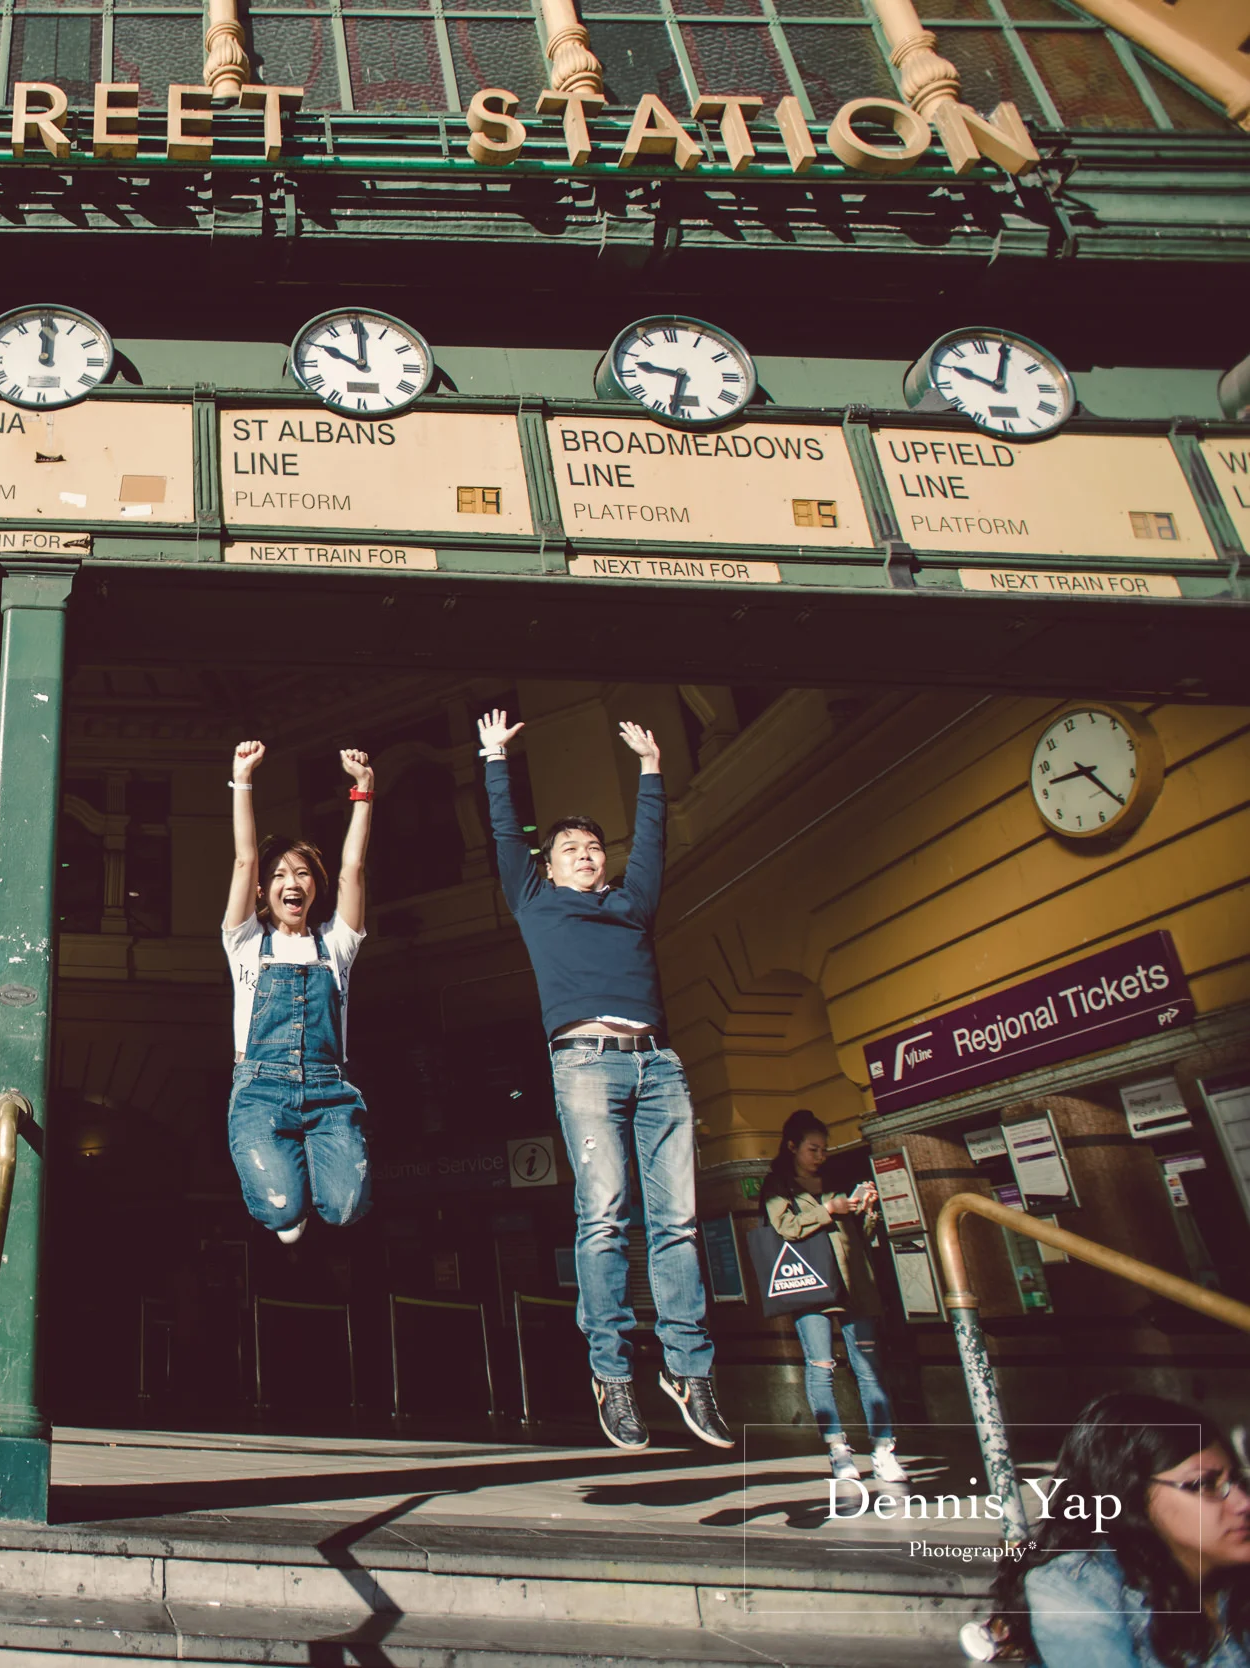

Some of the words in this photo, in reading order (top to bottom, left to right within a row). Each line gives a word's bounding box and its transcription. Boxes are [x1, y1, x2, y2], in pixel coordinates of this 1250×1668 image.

[465, 88, 1041, 175] STATION
[233, 418, 269, 442] ST
[278, 420, 396, 446] ALBANS
[560, 429, 824, 461] BROADMEADOWS
[888, 440, 1015, 467] UPFIELD
[233, 451, 300, 476] LINE
[567, 463, 635, 488] LINE
[899, 473, 969, 500] LINE
[235, 491, 352, 511] PLATFORM
[573, 503, 691, 524] PLATFORM
[910, 514, 1030, 536] PLATFORM
[22, 533, 61, 549] FOR
[250, 546, 299, 562] NEXT
[303, 547, 363, 563] TRAIN
[368, 549, 407, 564] FOR
[593, 559, 642, 575] NEXT
[646, 560, 704, 577] TRAIN
[710, 563, 750, 579] FOR
[990, 573, 1044, 590] NEXT
[1045, 575, 1103, 592] TRAIN
[1108, 577, 1150, 593] FOR
[952, 996, 1058, 1057] Regional
[1059, 964, 1170, 1019] Tickets
[436, 1154, 504, 1176] Service
[780, 1262, 805, 1277] ON
